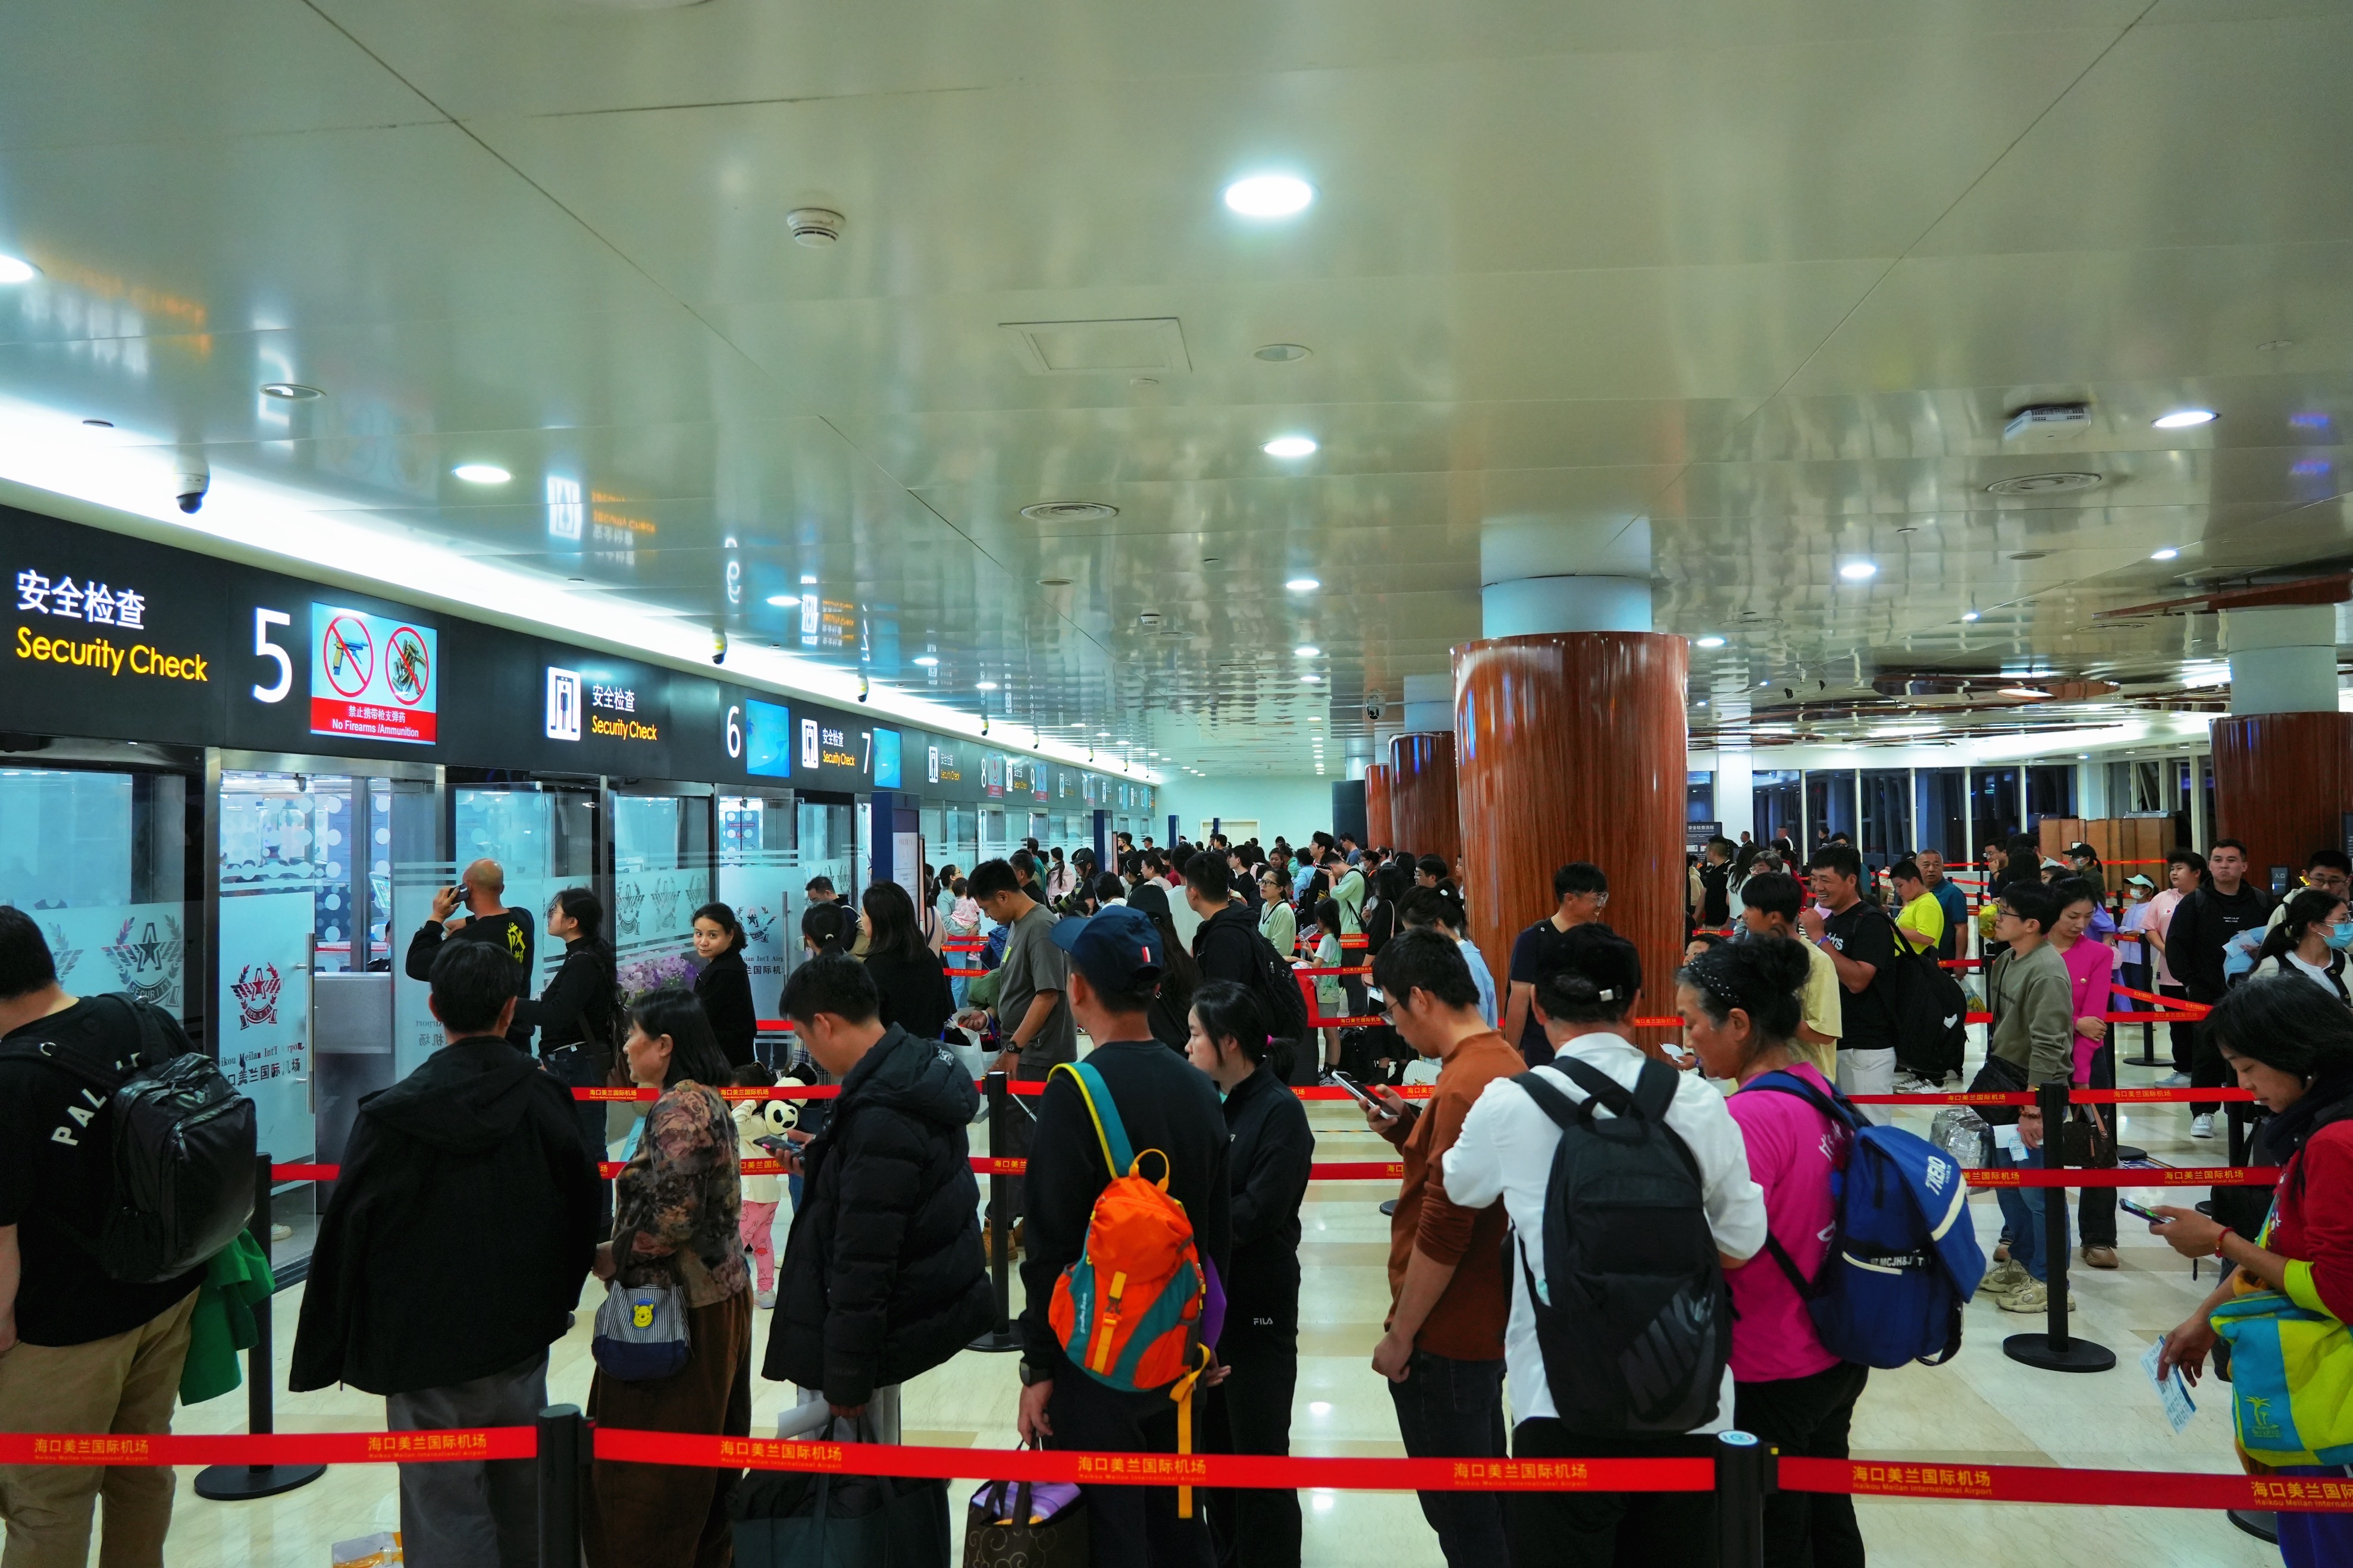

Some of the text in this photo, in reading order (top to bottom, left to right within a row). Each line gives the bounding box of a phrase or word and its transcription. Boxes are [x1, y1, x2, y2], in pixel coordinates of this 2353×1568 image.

[17, 569, 145, 630] 安全检查
[17, 626, 208, 682] Security Check
[253, 608, 293, 703] 5
[593, 683, 635, 712] 安全检查
[349, 705, 406, 723] 禁止携带枪支弹药
[332, 719, 419, 738] No Firearms /Ammunition
[592, 715, 657, 741] Security Check
[726, 705, 741, 758] 6
[822, 728, 844, 747] 安全检查
[823, 750, 855, 767] Security Check
[861, 732, 871, 773] 7
[981, 757, 986, 788] 8
[1030, 768, 1035, 794] 9
[1082, 777, 1088, 800] 10
[1118, 785, 1123, 804] 11
[747, 965, 784, 974] 兰国际机
[994, 1160, 1027, 1168] 海口美兰
[1387, 1164, 1403, 1172] 海口
[1963, 1172, 2020, 1180] 美兰国际机场
[2164, 1170, 2244, 1180] 海口美兰国际机场
[1253, 1317, 1274, 1325] FILA
[35, 1439, 148, 1453] 海口美兰国际机场
[368, 1434, 485, 1451] 海口美兰国际机场
[720, 1441, 842, 1461] 海口美兰国际机场
[1078, 1457, 1207, 1474] 海口美兰国际机场
[1453, 1463, 1587, 1479] 海口美兰国际机场
[1853, 1466, 1991, 1487] 海口美兰国际机场
[1882, 1483, 1909, 1491] Meilan
[1911, 1484, 1962, 1493] International
[2251, 1481, 2353, 1499] 海口美兰国际
[2254, 1498, 2284, 1506] Haikou
